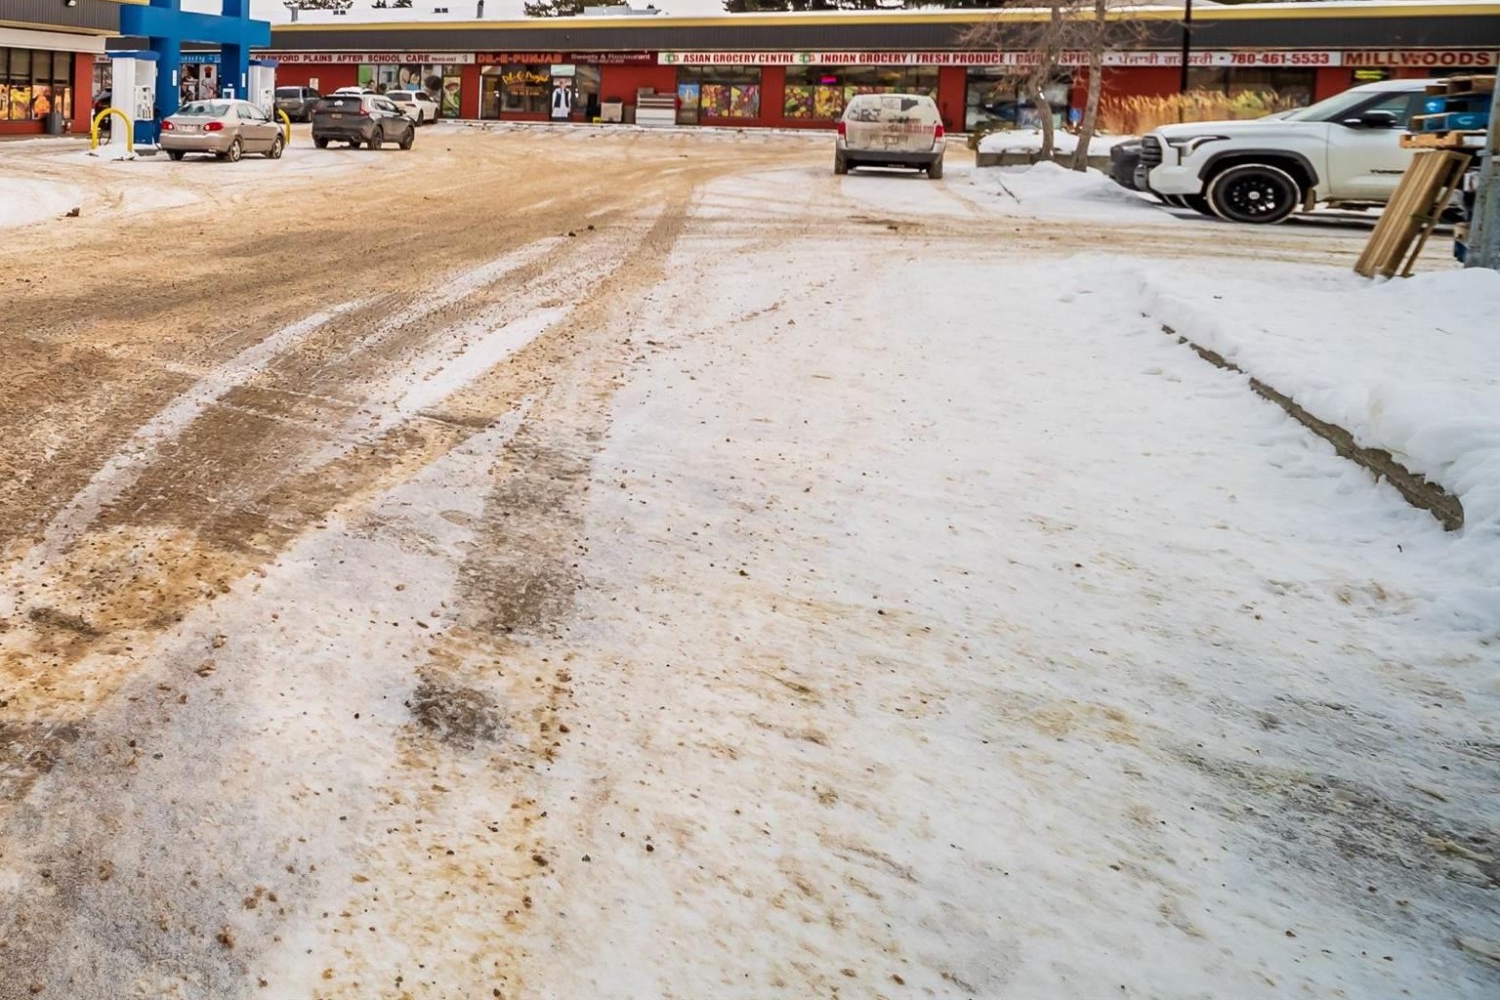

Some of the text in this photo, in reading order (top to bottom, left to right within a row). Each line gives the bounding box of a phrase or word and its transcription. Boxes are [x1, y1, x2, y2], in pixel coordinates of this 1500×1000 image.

[303, 54, 332, 62] PLAINS
[337, 54, 363, 62] AFTER
[367, 54, 401, 63] SCHOOL
[405, 54, 430, 62] CARE
[477, 53, 562, 64] DIL-E-PUNJAB
[683, 54, 711, 63] ASIAN
[713, 54, 756, 63] GROCERY
[758, 54, 794, 63] CENTRE
[820, 54, 856, 63] INDIAN
[859, 54, 907, 63] GROCERY
[916, 53, 950, 63] FRESH
[953, 53, 1005, 63] PRODUCE
[1230, 53, 1330, 65] 780-461-5533
[1345, 52, 1490, 65] MILLWOODS
